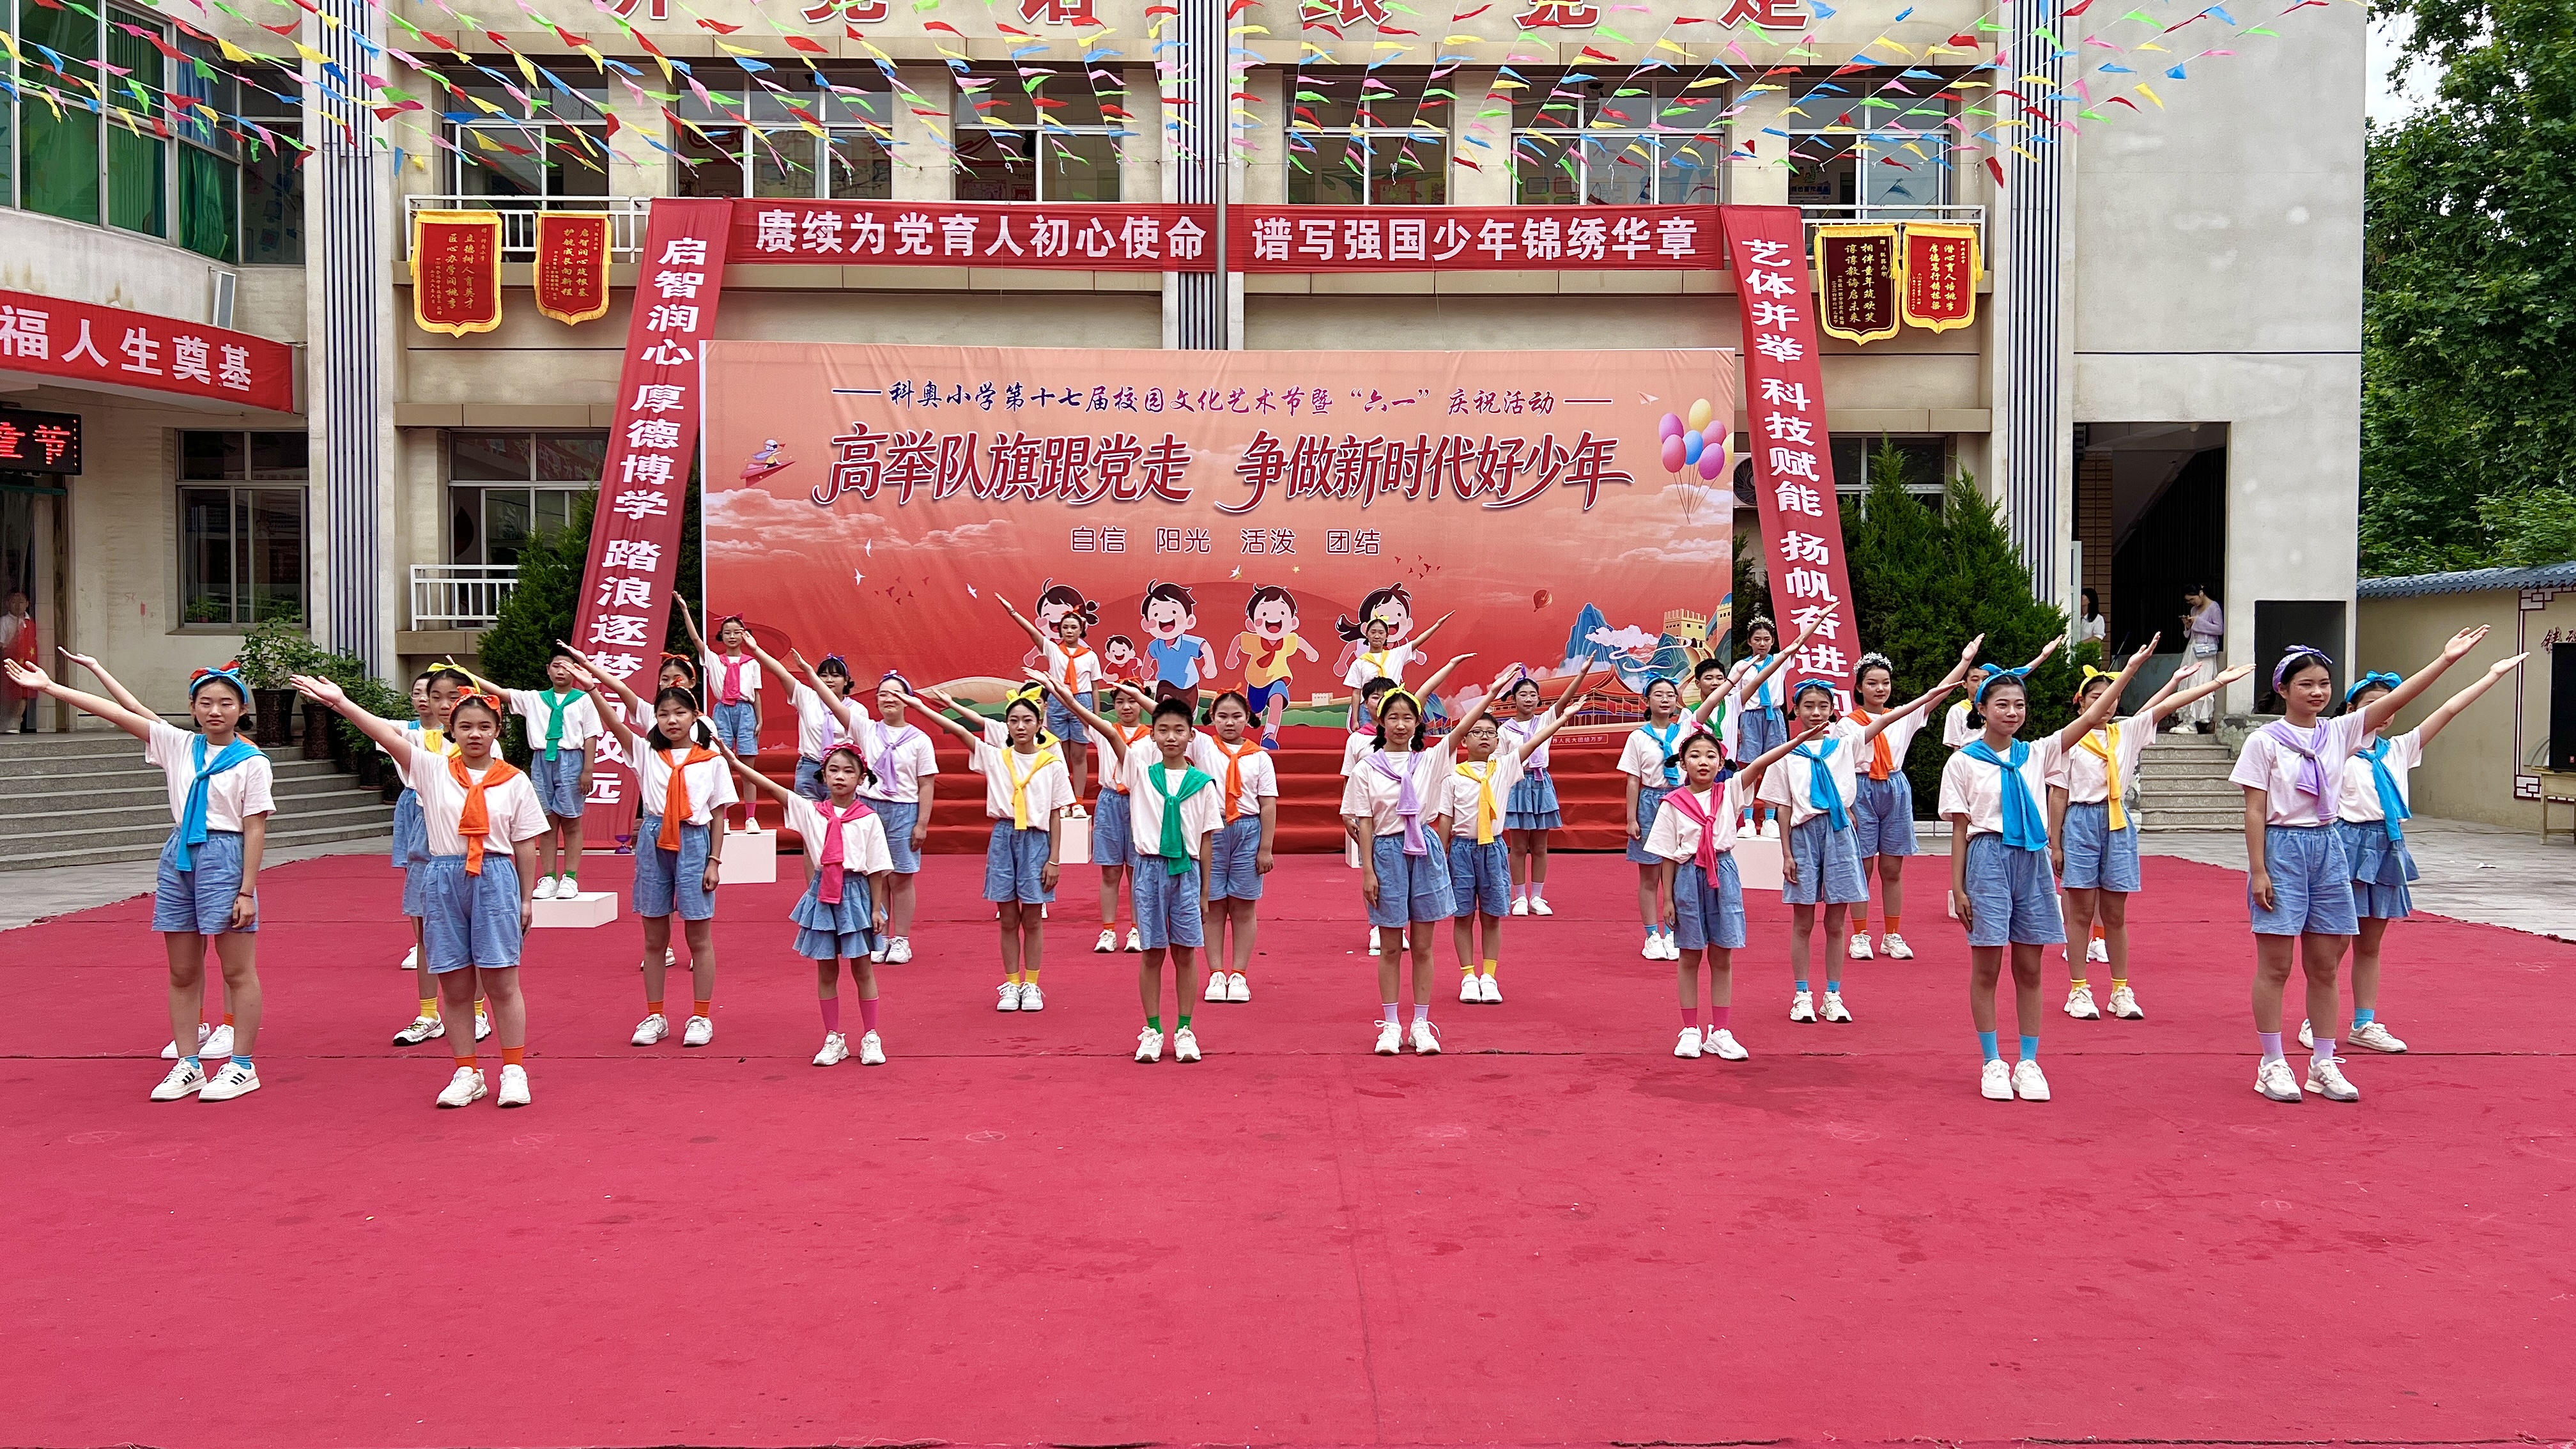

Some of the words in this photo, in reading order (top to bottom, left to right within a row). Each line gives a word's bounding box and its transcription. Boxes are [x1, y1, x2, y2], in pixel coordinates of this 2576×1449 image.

[461, 233, 475, 309] 立德树人育英才
[755, 208, 1207, 260] 赓续为党育人初心使命
[1251, 215, 1699, 261] 谱写强国少年锦绣华章
[640, 236, 707, 366] 启智润心
[1741, 238, 1804, 364] 艺体并举
[1844, 244, 1861, 323] 谆谆教诲启未来
[1860, 243, 1877, 323] 相伴童年筑欢笑
[0, 305, 252, 392] 福人生奠基
[613, 384, 686, 520] 厚德博学
[811, 421, 1194, 506] 高举队旗跟党走
[1214, 428, 1635, 513] 争做新时代好少年
[1761, 377, 1823, 517] 科技赋能
[1071, 526, 1127, 554] 自信
[1155, 526, 1212, 554] 阳光
[1240, 527, 1297, 555] 活泼
[1326, 529, 1382, 555] 团结
